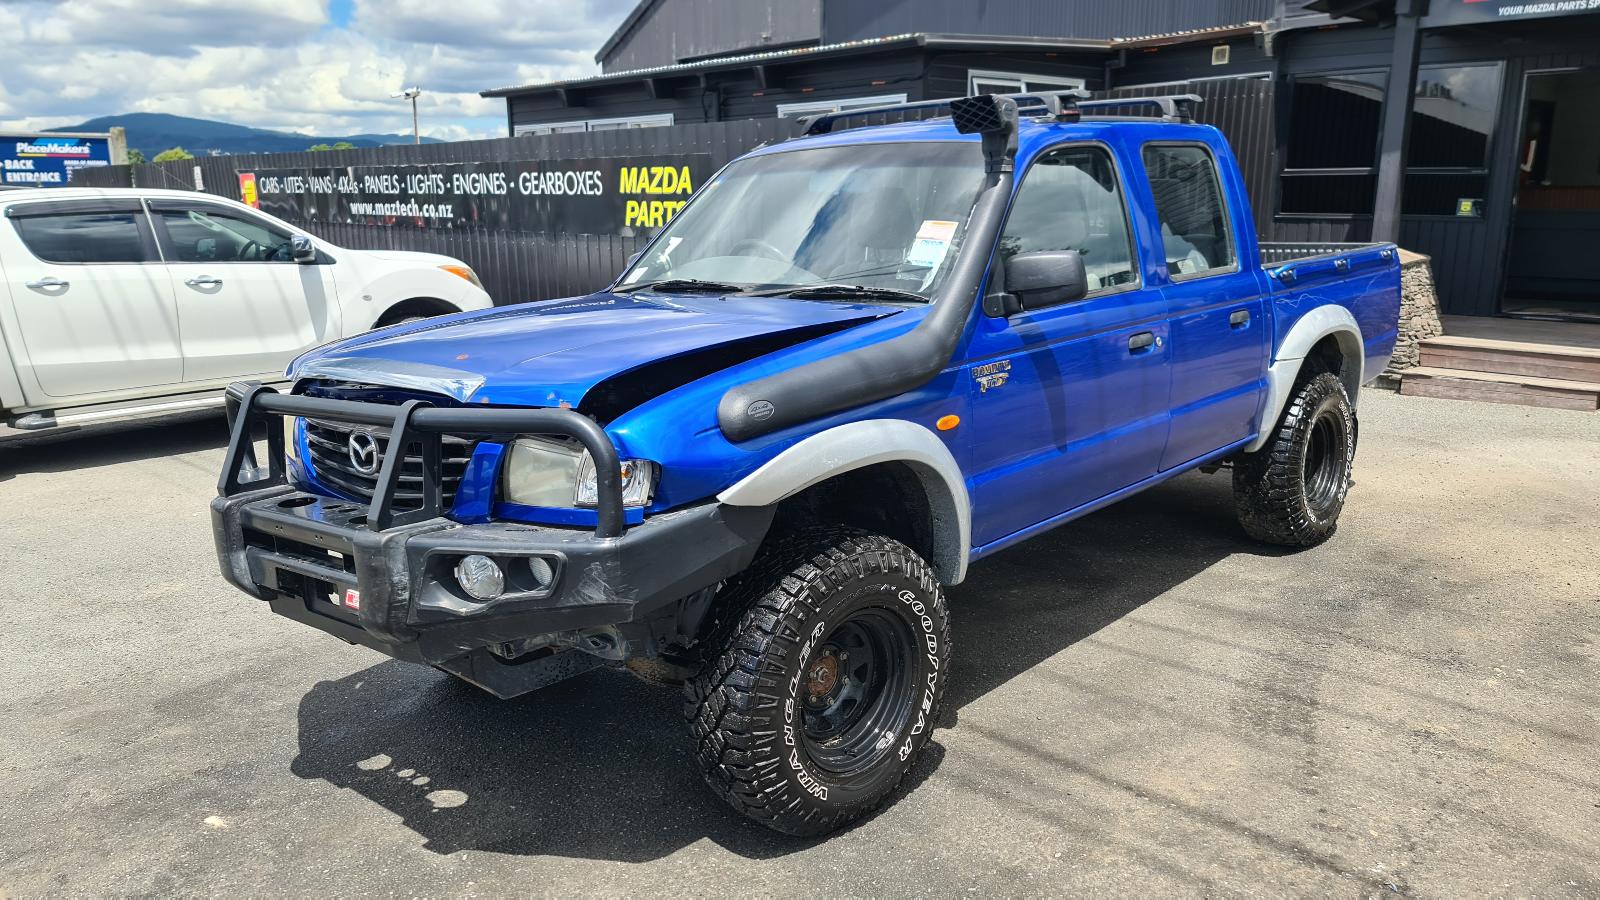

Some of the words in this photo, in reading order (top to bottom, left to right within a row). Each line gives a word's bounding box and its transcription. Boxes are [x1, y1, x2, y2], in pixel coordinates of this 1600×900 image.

[1498, 6, 1522, 16] YOUR
[1523, 3, 1555, 14] MAZDA
[1557, 0, 1588, 11] PARTS
[16, 142, 90, 154] PlaceMakers
[4, 159, 35, 170] BACK
[6, 171, 62, 182] ENTRANCE
[259, 176, 279, 194] CARS
[284, 176, 304, 194] UTES
[309, 175, 332, 194] VANS
[365, 174, 400, 194] PANELS
[407, 174, 445, 195] LIGHTS
[453, 173, 507, 195] ENGINES
[519, 171, 603, 195] GEARBOXES
[619, 166, 693, 194] MAZDA
[350, 198, 454, 218] www.maztech.co.nz
[898, 589, 939, 761] GOODYEAR
[783, 621, 829, 801] WRANGLER
